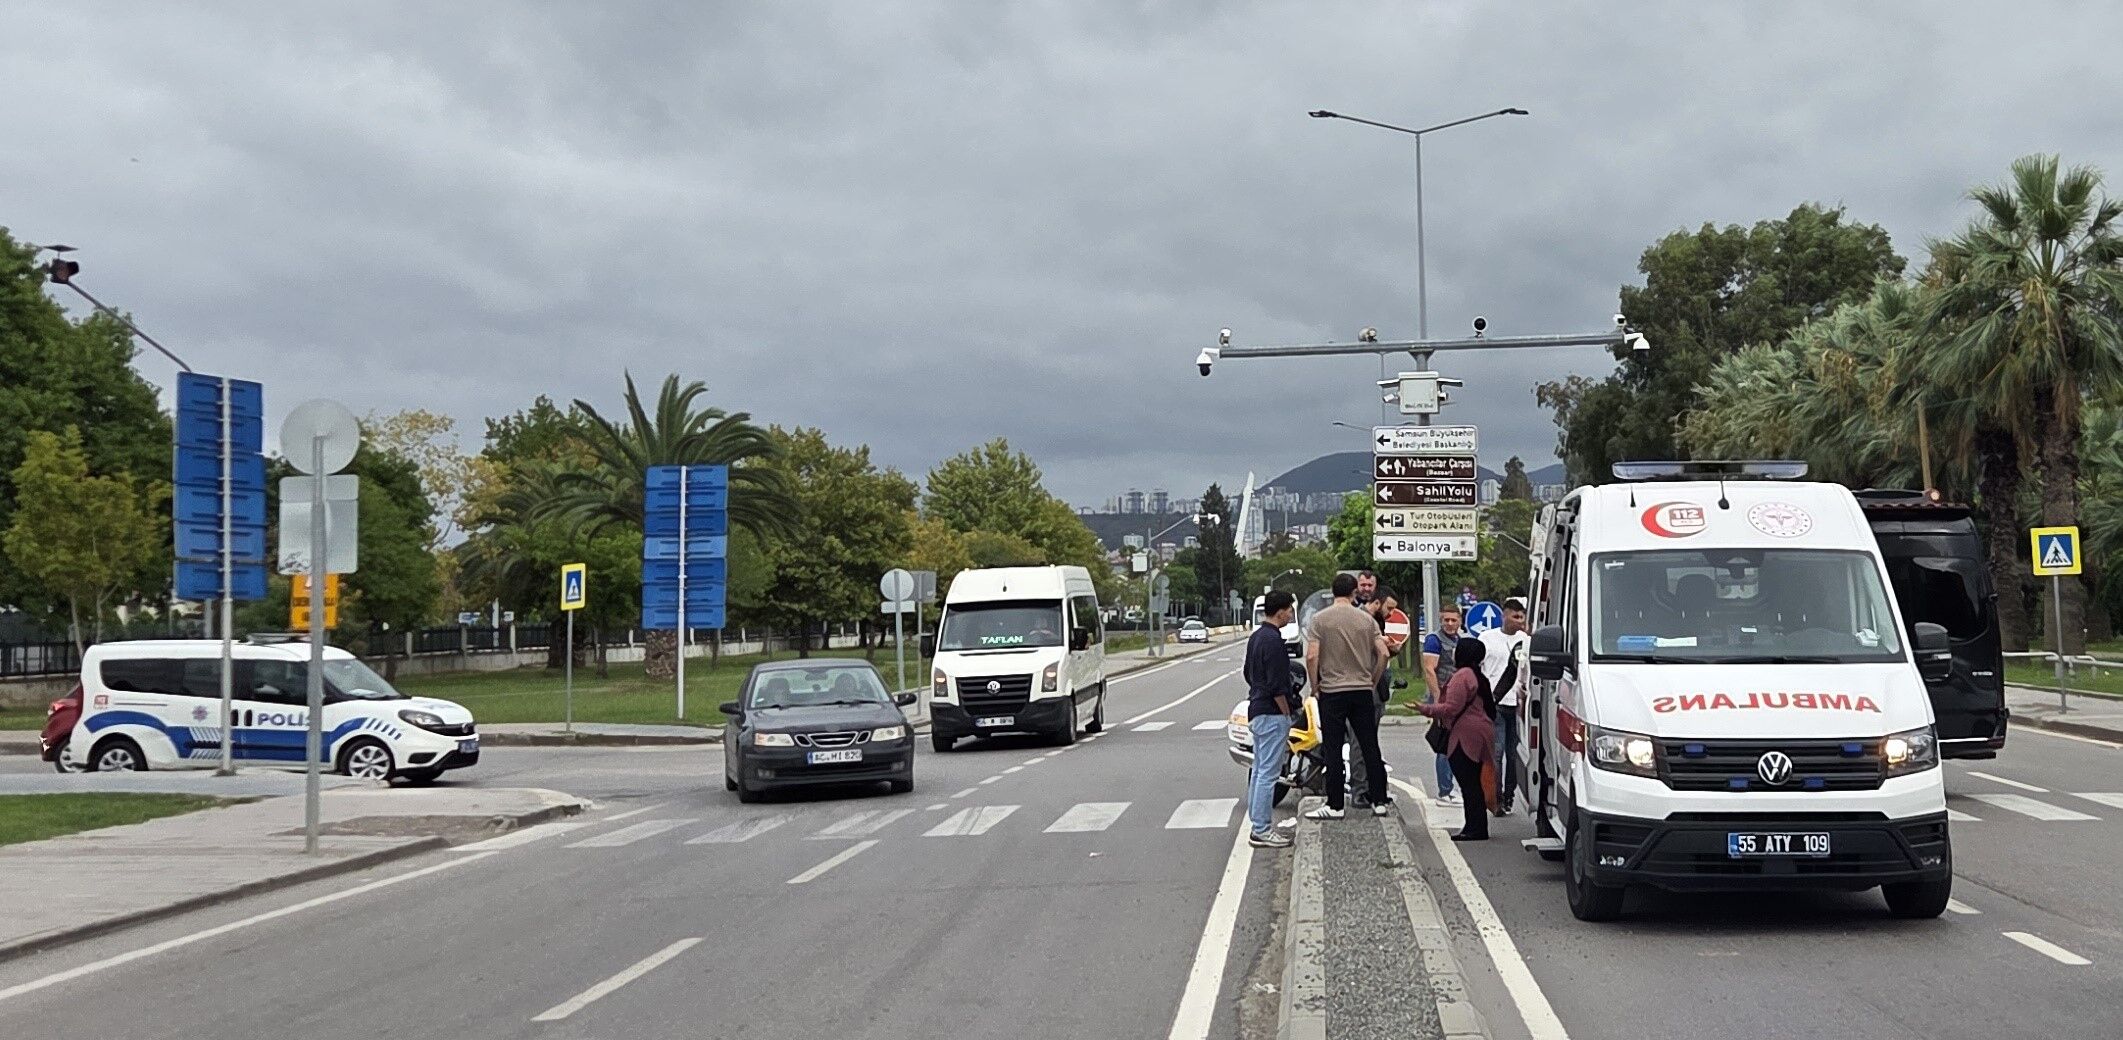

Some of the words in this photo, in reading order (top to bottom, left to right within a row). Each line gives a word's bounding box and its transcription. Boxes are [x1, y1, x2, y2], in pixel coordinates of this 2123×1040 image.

[1416, 485, 1446, 496] Sahil
[1447, 485, 1473, 496] Yolu
[1672, 510, 1700, 520] 112
[1412, 522, 1447, 530] Otopark
[1397, 541, 1451, 555] Balonya
[1738, 835, 1757, 852] 55
[1765, 835, 1791, 852] ATY
[1803, 835, 1828, 852] 109
